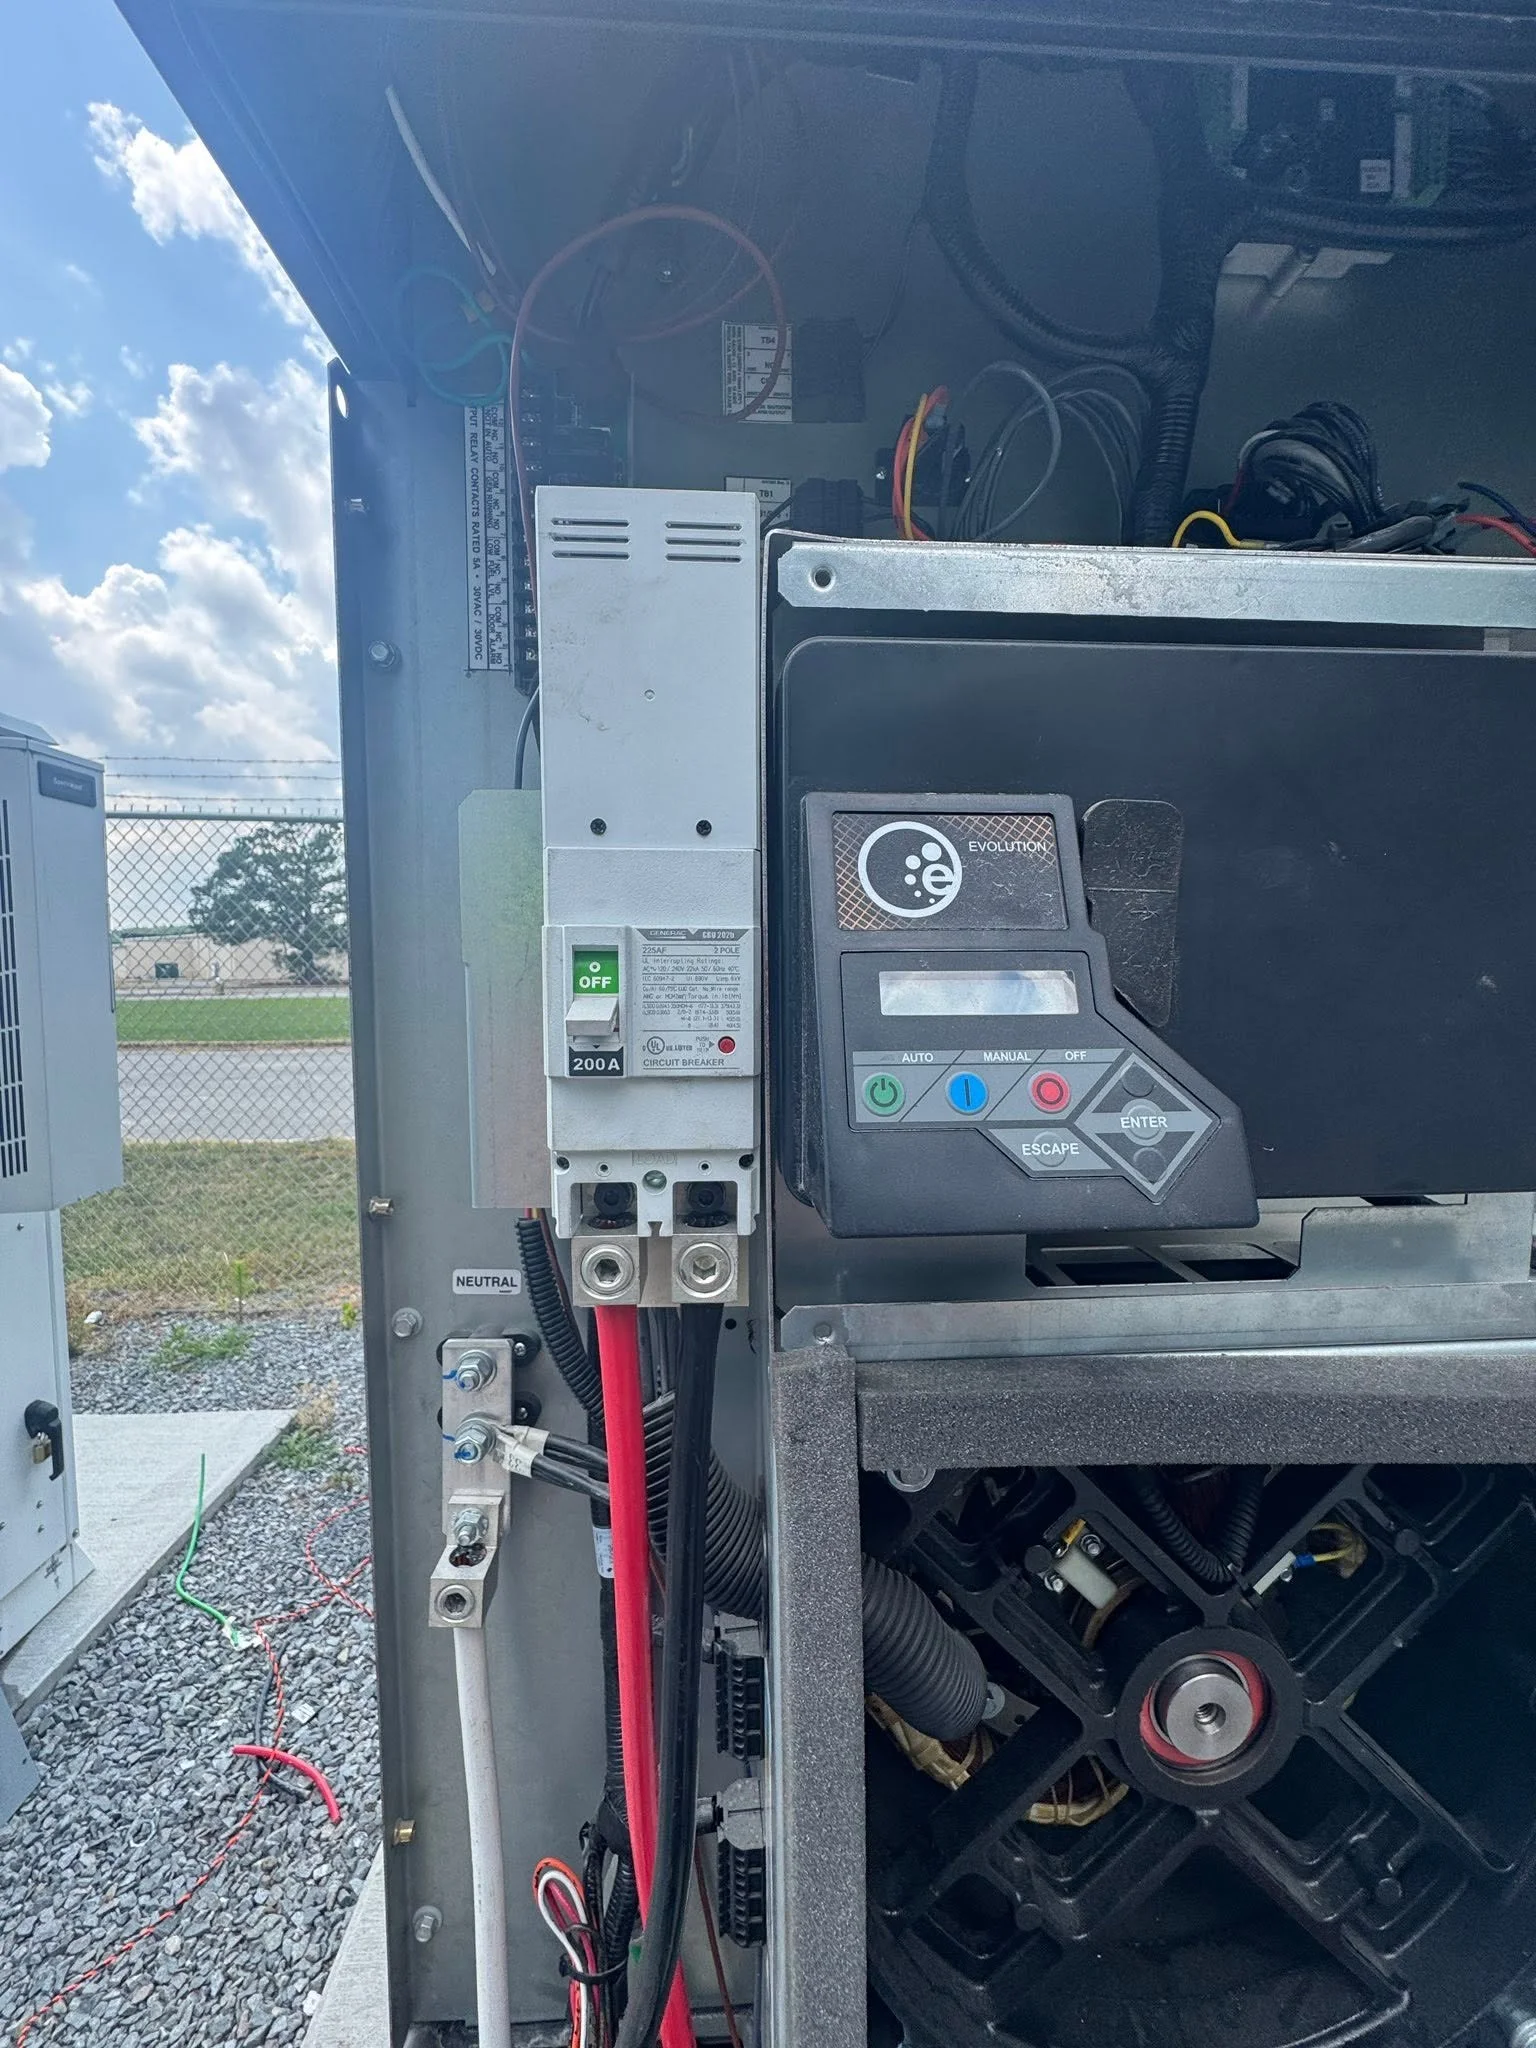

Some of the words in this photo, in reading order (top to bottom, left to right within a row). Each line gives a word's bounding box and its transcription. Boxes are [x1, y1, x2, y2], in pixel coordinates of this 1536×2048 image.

[492, 429, 498, 440] NC
[470, 433, 478, 463] RELAY
[492, 452, 498, 464] NO
[471, 468, 480, 517] CONTACTS
[493, 499, 499, 509] NC
[493, 519, 499, 530] NO
[473, 558, 480, 569] 5A
[495, 563, 501, 574] NC
[495, 584, 501, 594] NO
[473, 586, 481, 616] 30VAC
[496, 632, 502, 642] NC
[474, 629, 482, 660] 30VDC
[497, 653, 502, 664] NO
[968, 840, 1047, 852] EVOLUTION
[642, 946, 667, 954] 225AF
[714, 946, 719, 954] 2
[720, 946, 740, 954] POLE
[579, 975, 612, 989] OFF
[643, 1058, 680, 1067] CIRCUIT
[682, 1058, 725, 1067] BREAKER
[902, 1052, 934, 1063] AUTO
[983, 1051, 1031, 1062] MANUAL
[1065, 1051, 1087, 1061] OFF
[573, 1058, 606, 1071] 200
[607, 1058, 620, 1071] A
[1120, 1116, 1168, 1128] ENTER
[1022, 1143, 1079, 1156] ESCAPE
[456, 1276, 518, 1287] NEUTRAL
